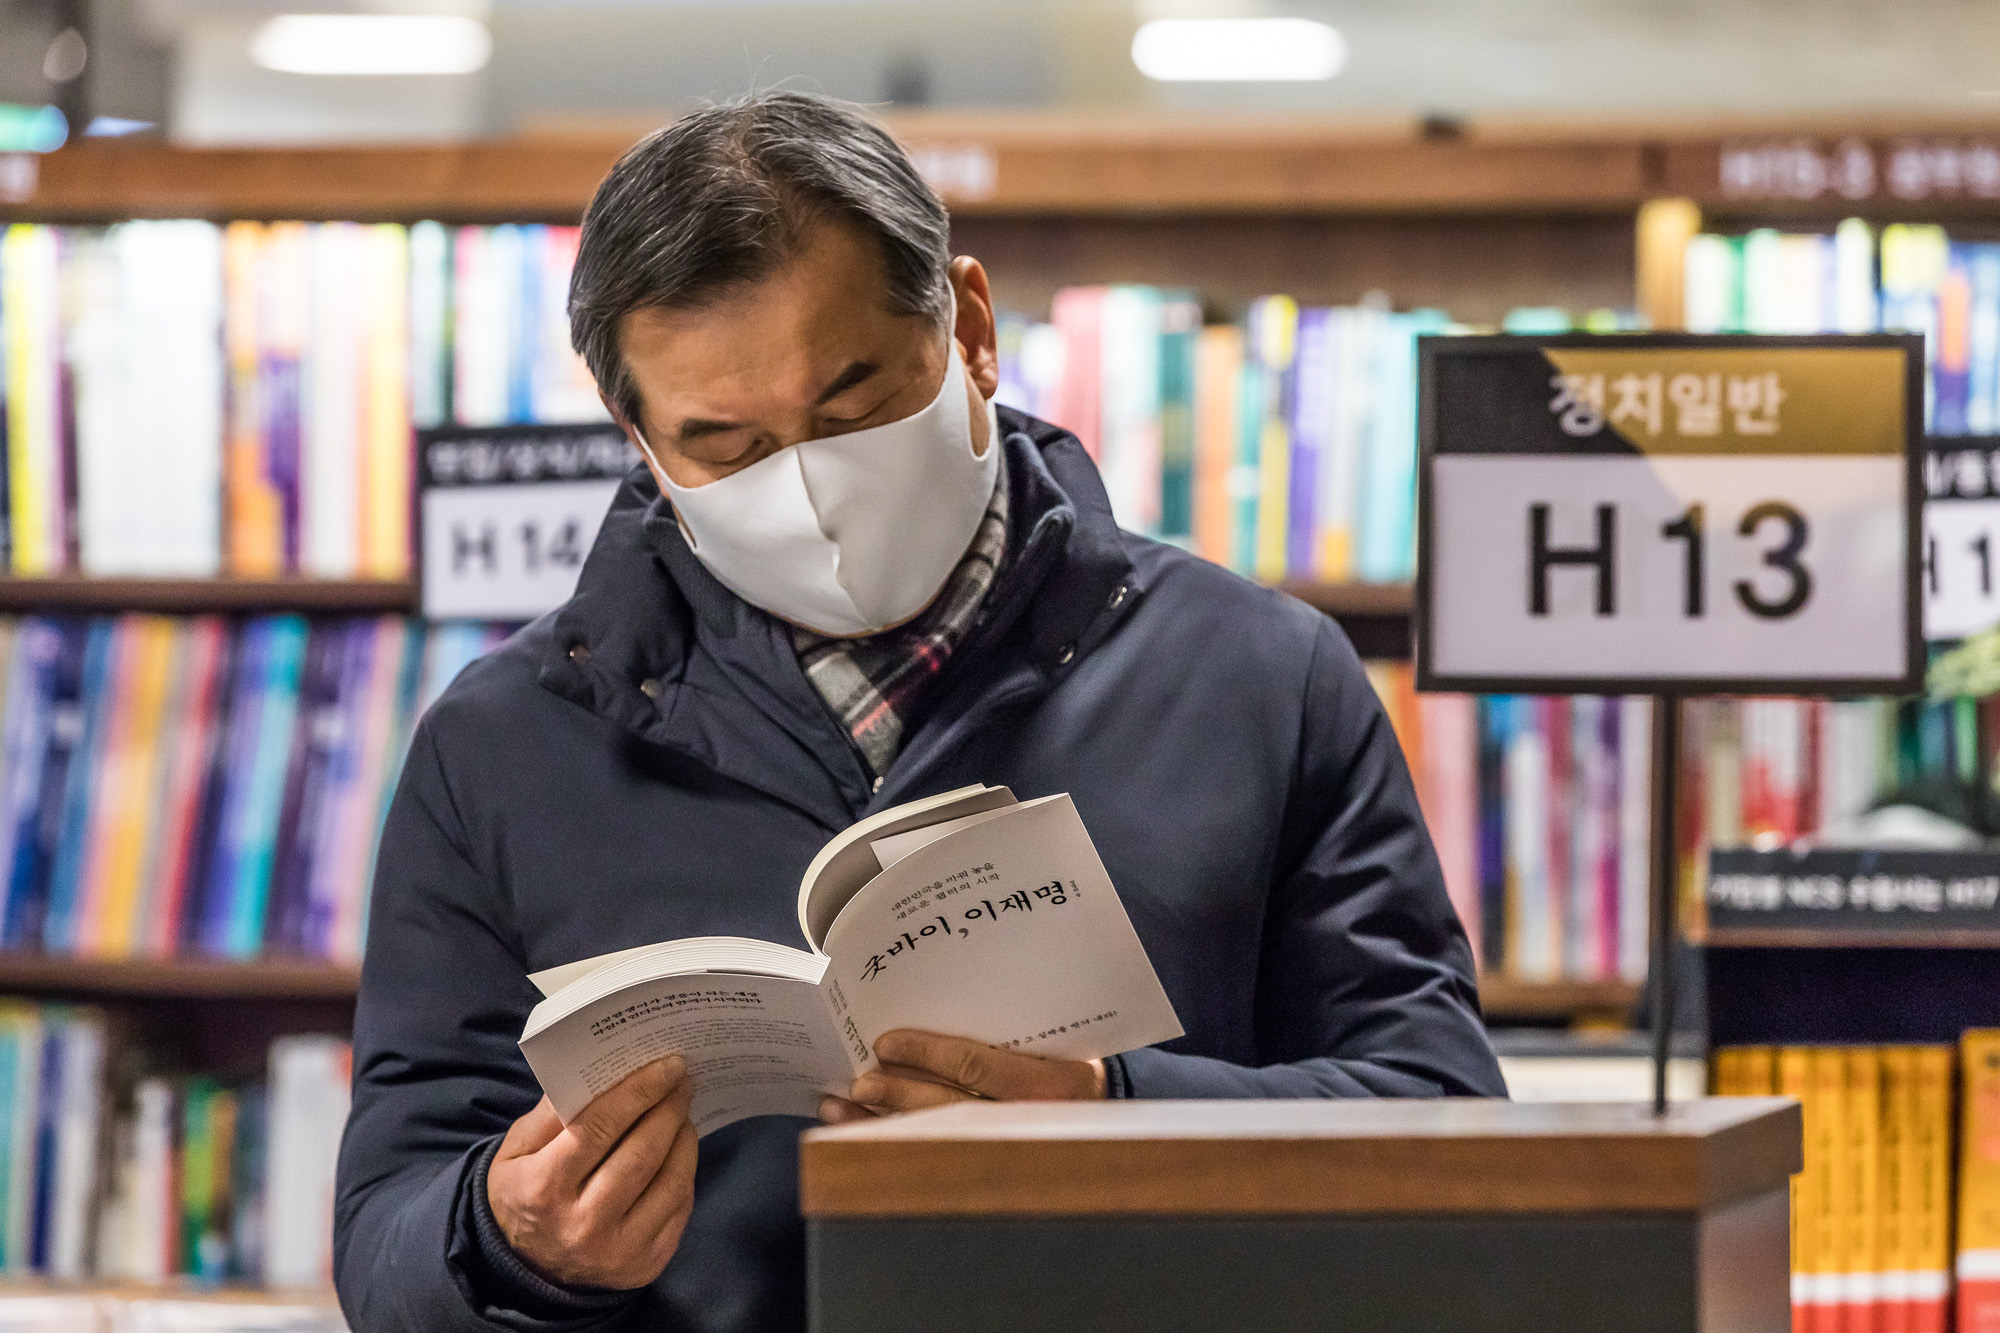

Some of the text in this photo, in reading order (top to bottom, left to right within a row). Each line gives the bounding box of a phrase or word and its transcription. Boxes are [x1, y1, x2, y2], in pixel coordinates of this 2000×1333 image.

[1549, 371, 1787, 437] 정치일반
[891, 881, 943, 912] 대한민국을
[896, 872, 1000, 921] 새로운 챕터의 시작
[965, 881, 1067, 921] 이재명
